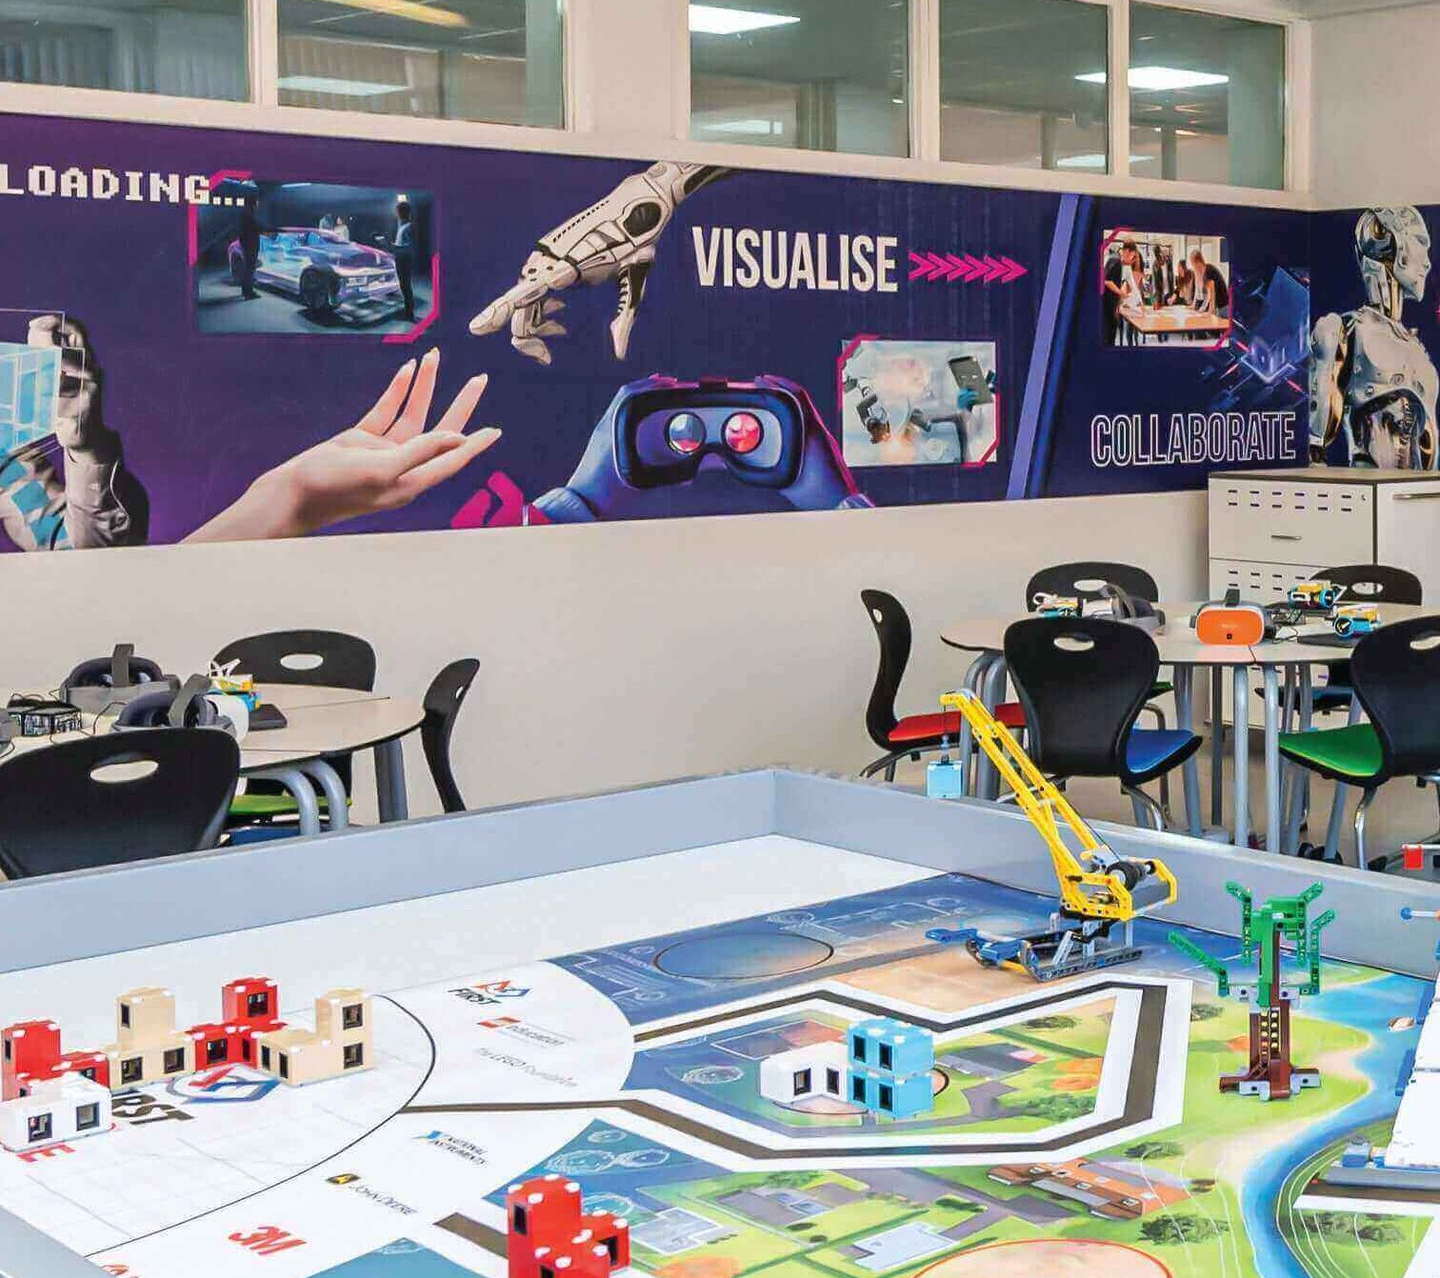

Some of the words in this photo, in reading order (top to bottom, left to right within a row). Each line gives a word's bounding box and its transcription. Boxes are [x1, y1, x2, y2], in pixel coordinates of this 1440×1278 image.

[692, 226, 897, 292] VISUALISE
[1090, 411, 1296, 467] COLLABORATE
[228, 1225, 307, 1255] 3M
